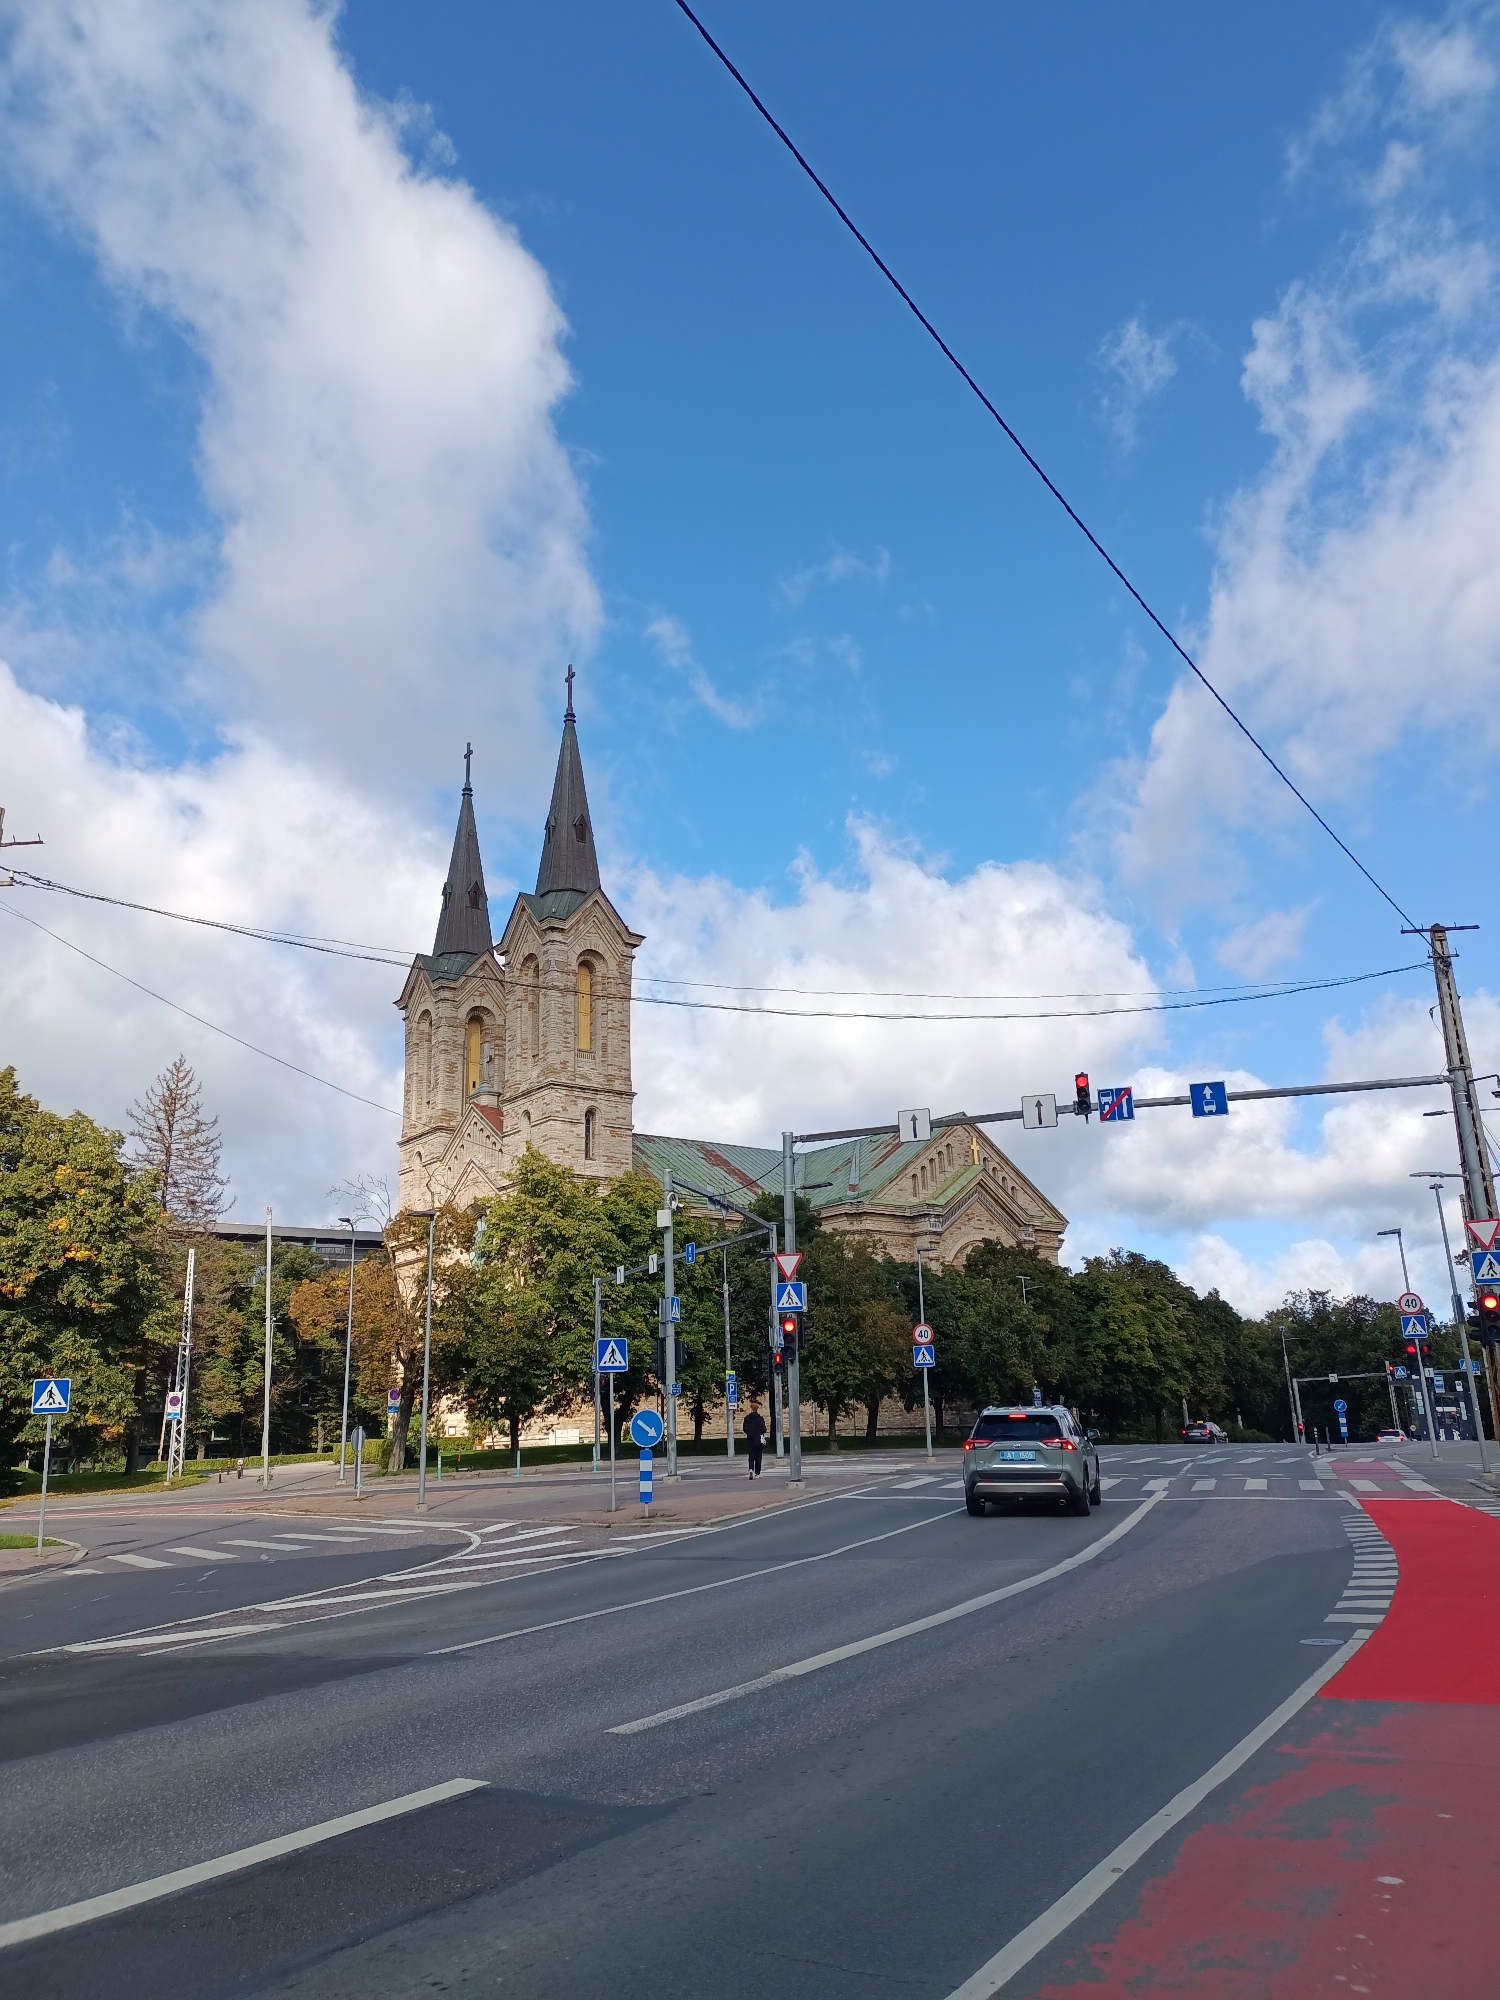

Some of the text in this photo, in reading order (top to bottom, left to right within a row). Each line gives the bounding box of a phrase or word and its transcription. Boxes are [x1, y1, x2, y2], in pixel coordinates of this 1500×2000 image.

[1404, 1298, 1418, 1308] 40
[918, 1330, 929, 1339] 40
[730, 1384, 734, 1394] P
